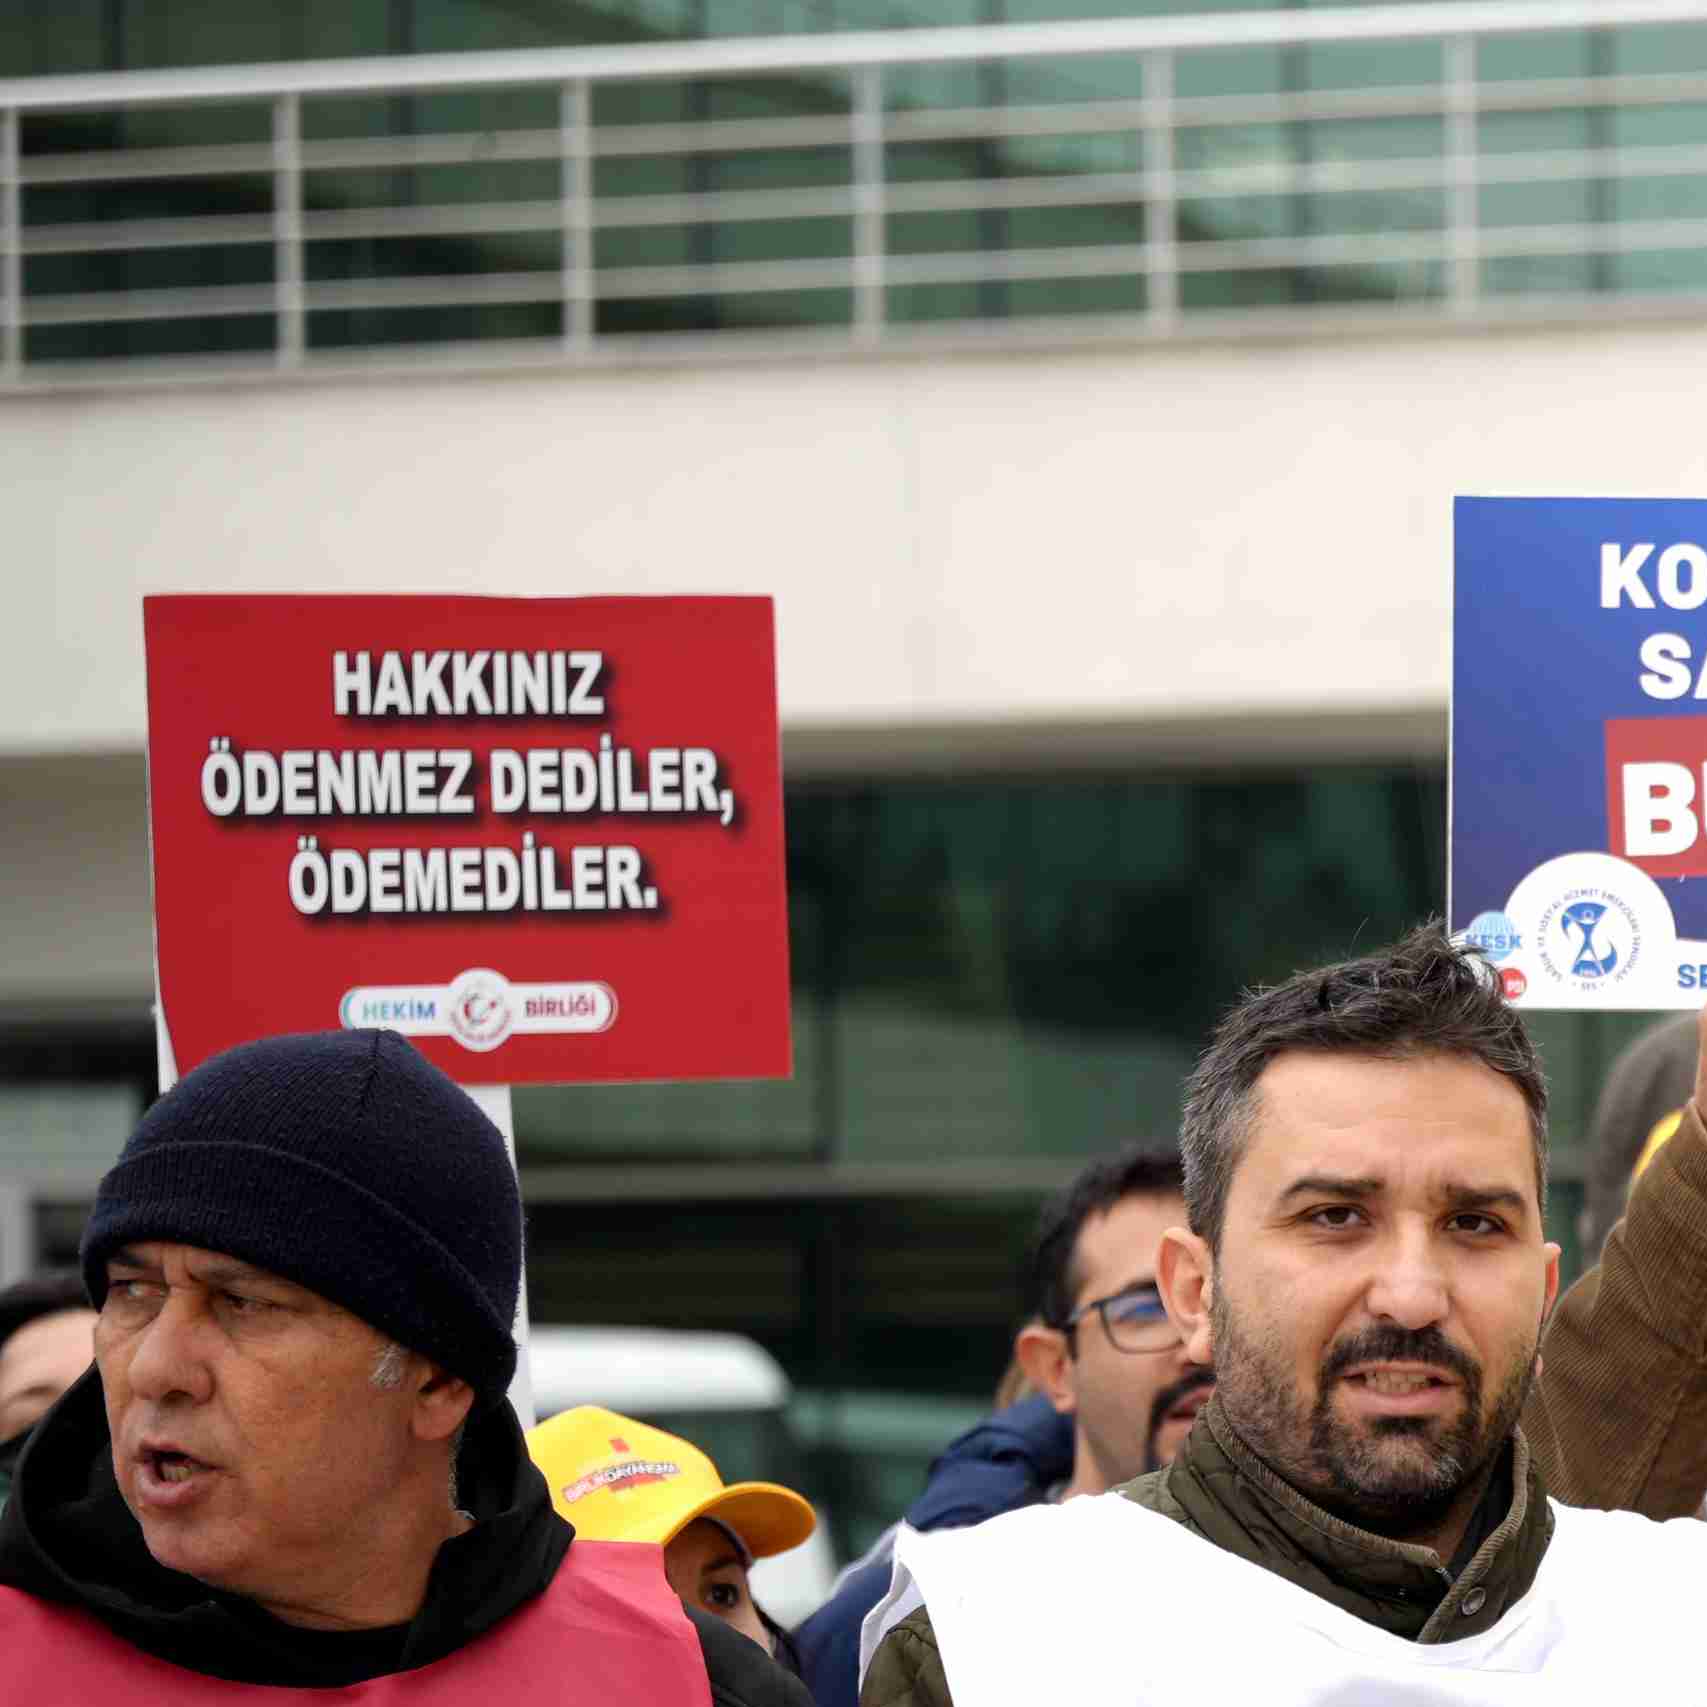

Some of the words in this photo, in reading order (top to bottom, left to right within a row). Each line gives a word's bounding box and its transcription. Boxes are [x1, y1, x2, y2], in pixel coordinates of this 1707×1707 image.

[334, 651, 604, 715] HAKKINIZ
[201, 737, 474, 815] ÖDENMEZ
[491, 734, 734, 824] DEDİLER,
[289, 832, 657, 913] ÖDEMEDİLER.
[362, 997, 435, 1021] HEKİM
[525, 995, 596, 1017] BİRLİĞİ
